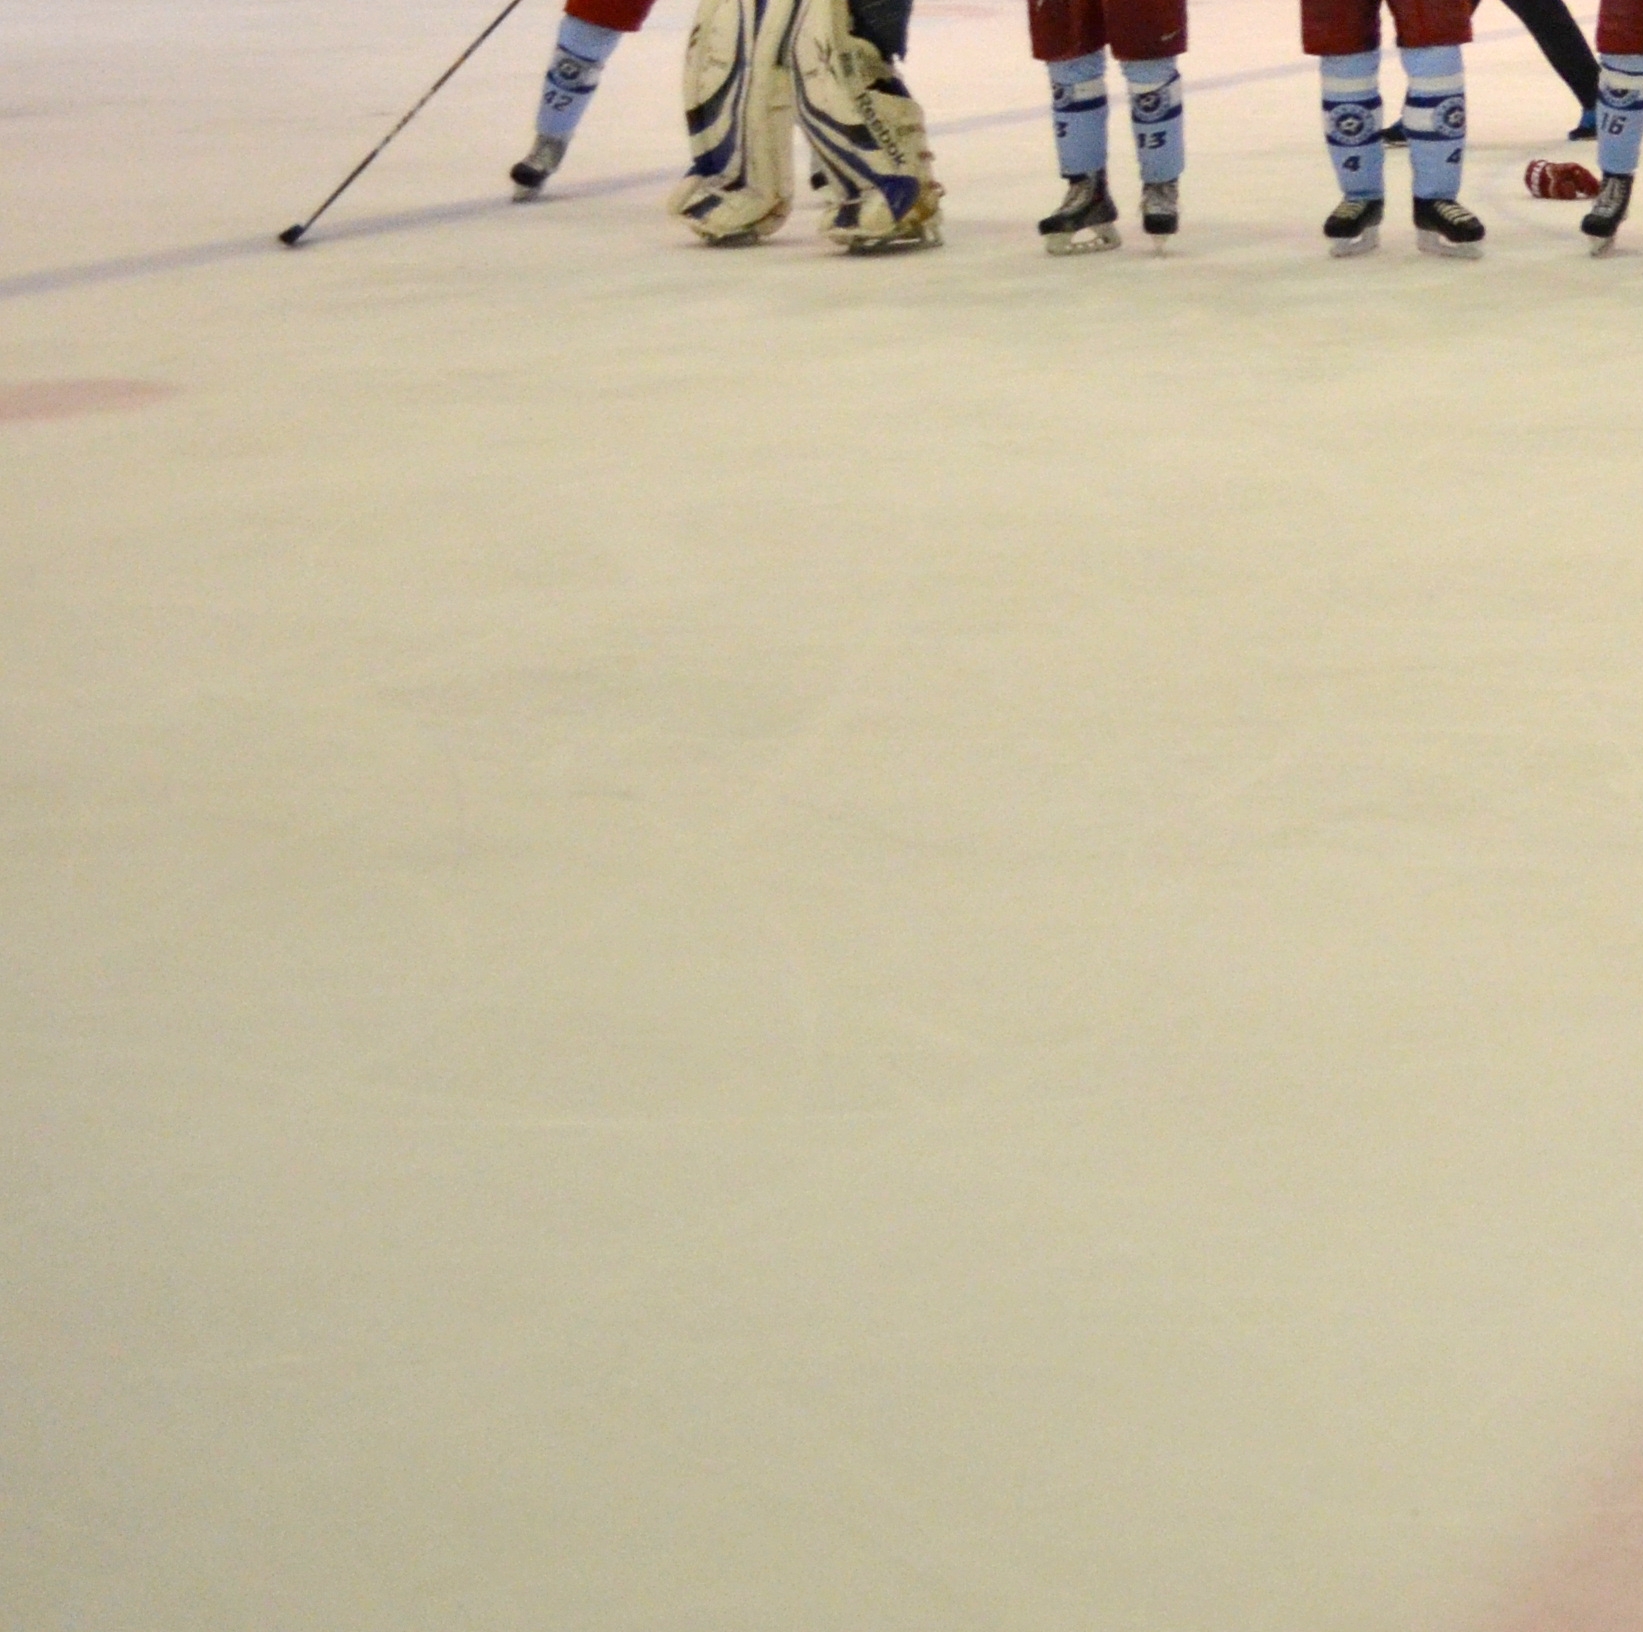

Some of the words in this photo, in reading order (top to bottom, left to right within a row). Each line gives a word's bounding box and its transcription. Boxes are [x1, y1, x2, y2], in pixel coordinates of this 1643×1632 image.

[856, 91, 906, 167] Reebok
[1054, 120, 1068, 138] 3
[1137, 131, 1167, 149] 13
[1342, 154, 1361, 172] 4
